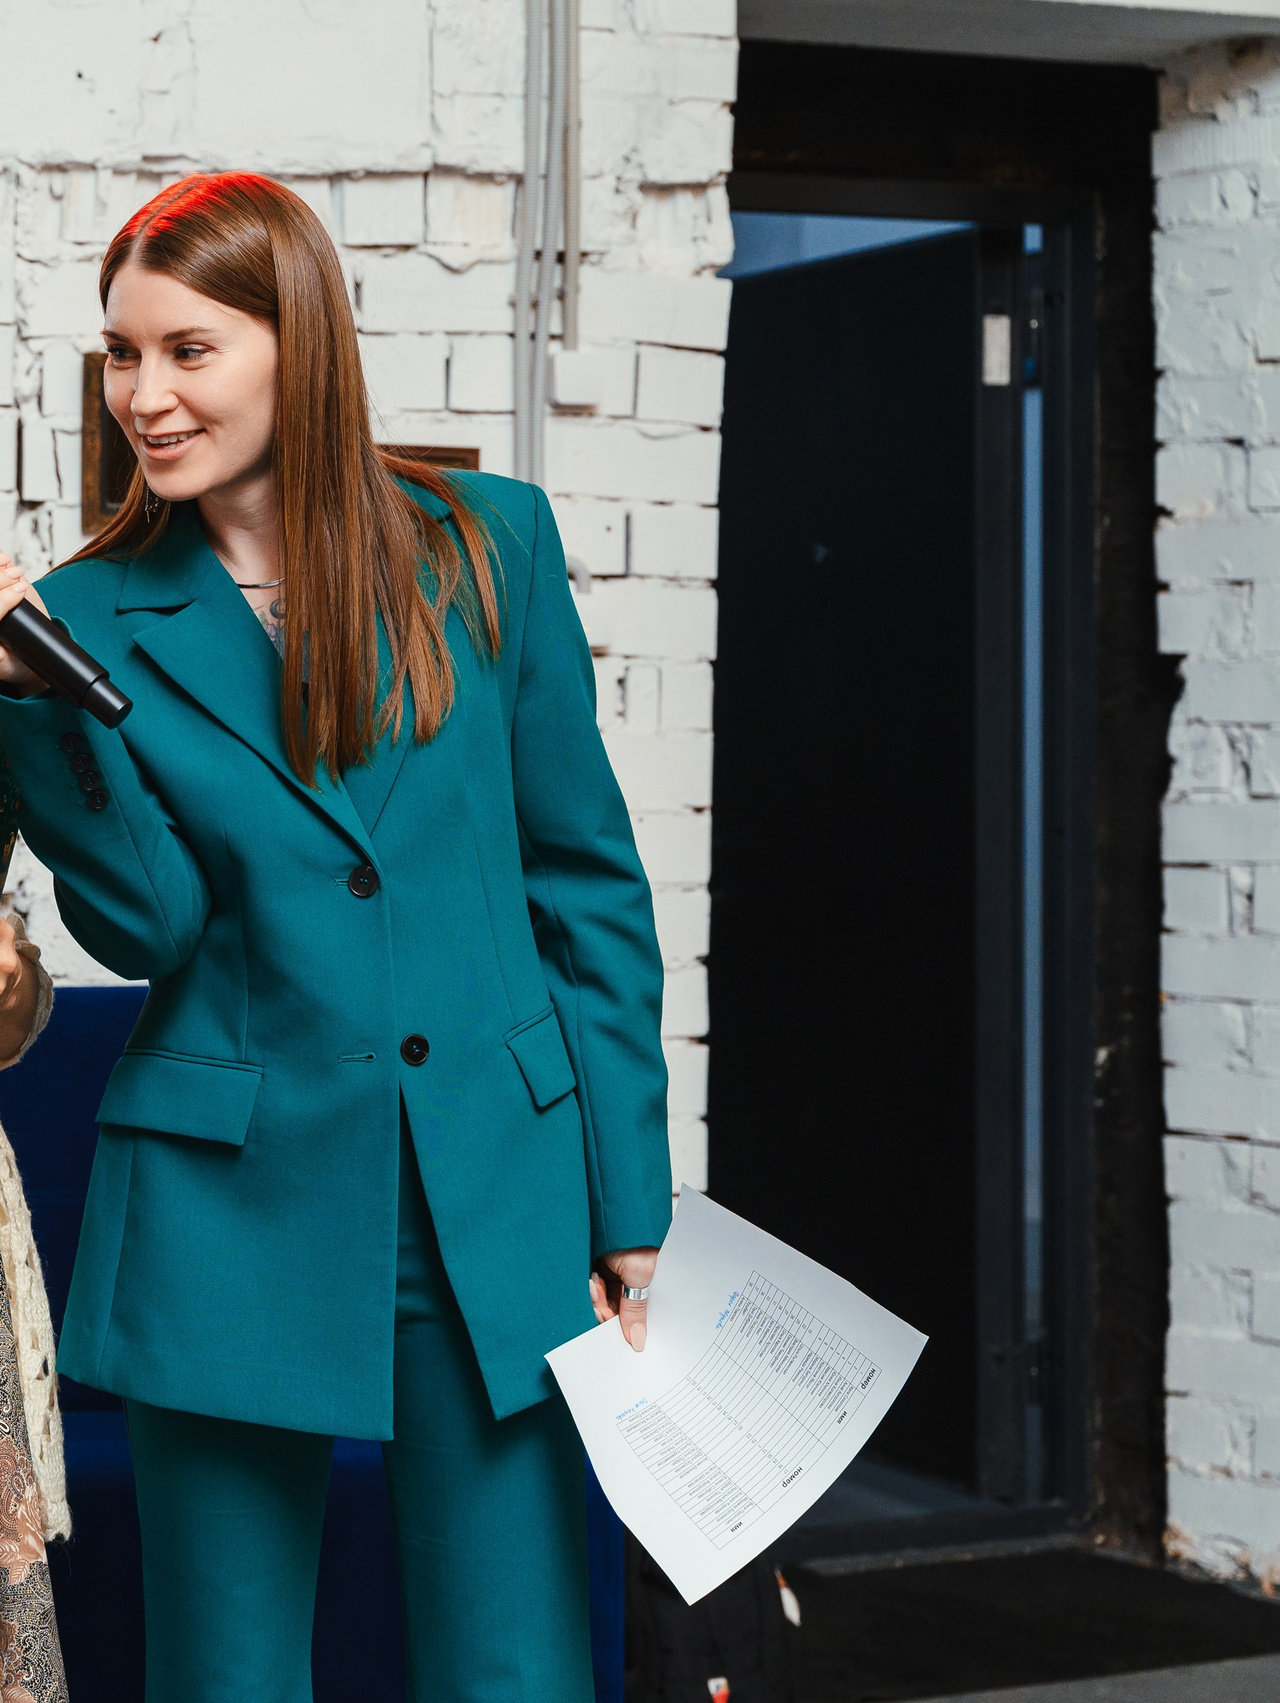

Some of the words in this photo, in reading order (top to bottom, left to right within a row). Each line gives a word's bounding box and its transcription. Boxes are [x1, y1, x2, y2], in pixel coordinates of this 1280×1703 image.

[786, 1339, 798, 1355] Виктория
[808, 1356, 820, 1370] Марина
[813, 1361, 825, 1378] Кристина
[860, 1368, 877, 1390] номер
[836, 1410, 848, 1425] имя
[781, 1466, 803, 1488] номер
[730, 1521, 743, 1533] имя
